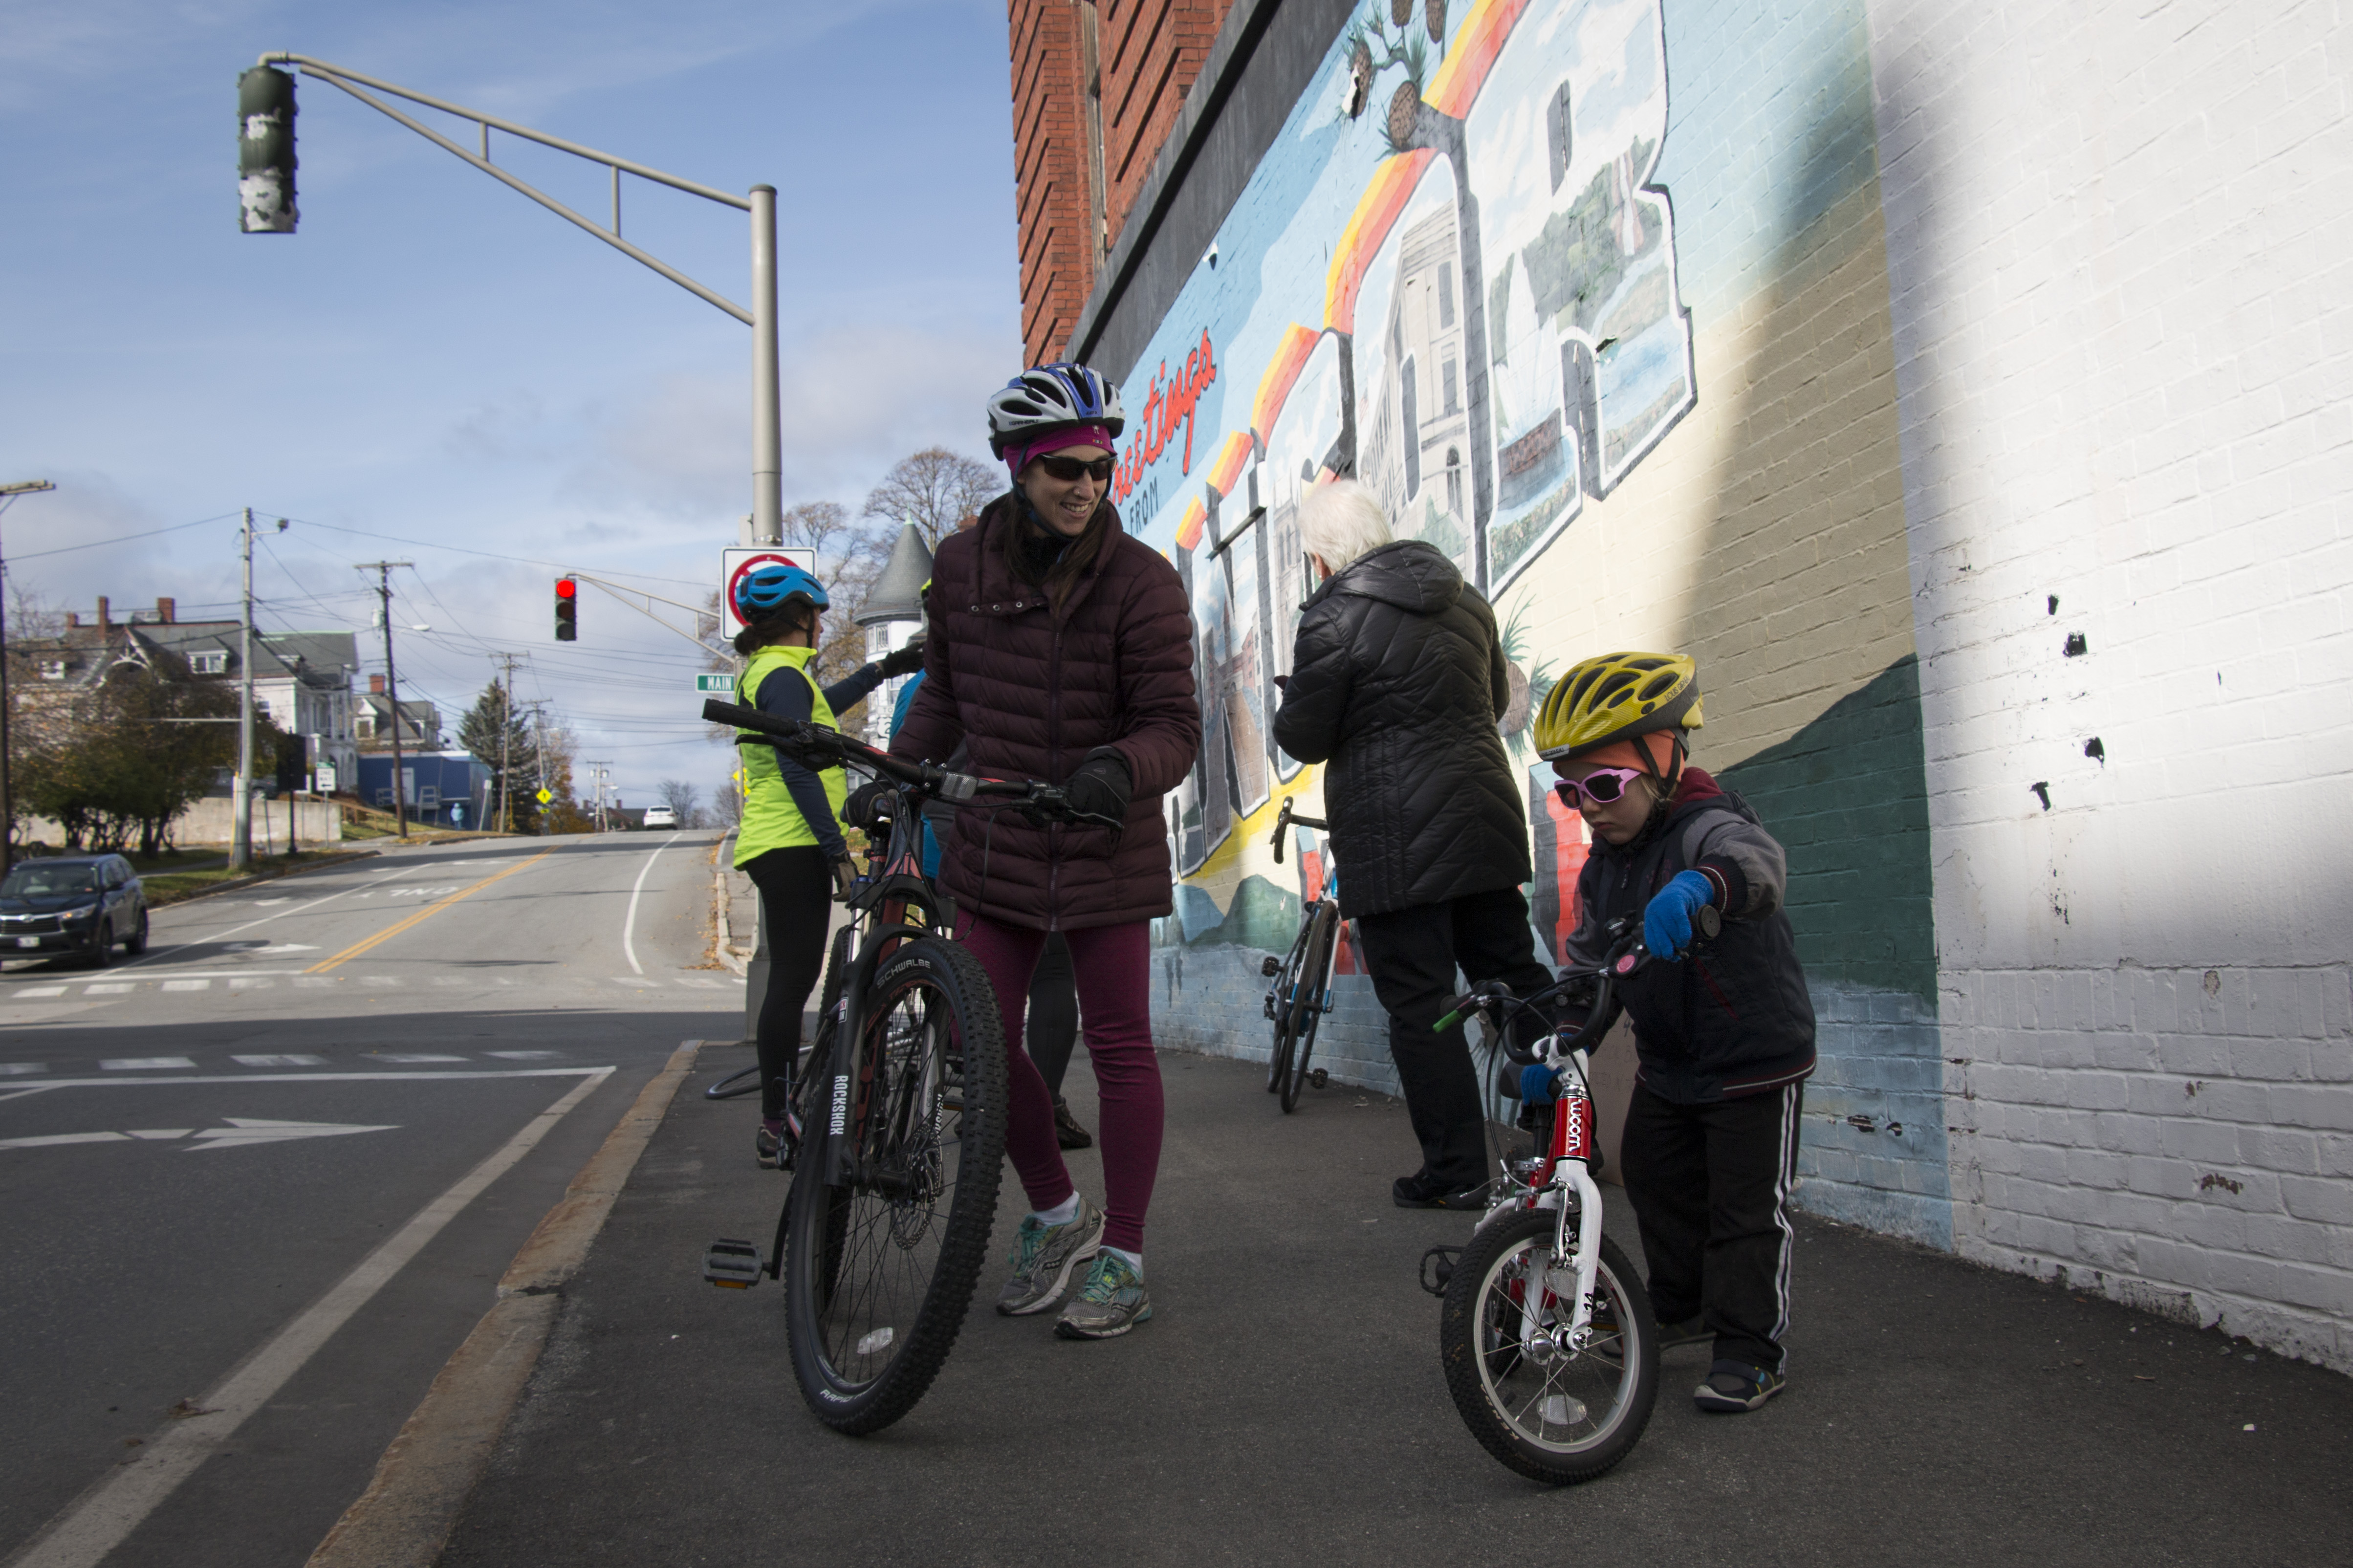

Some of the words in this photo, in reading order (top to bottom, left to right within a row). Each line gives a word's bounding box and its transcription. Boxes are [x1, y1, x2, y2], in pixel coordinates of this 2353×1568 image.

[1108, 326, 1217, 506] reetings
[1129, 477, 1158, 536] FROM
[707, 676, 731, 690] MAIN
[877, 958, 931, 989] SCHWALBE
[829, 1075, 849, 1136] ROCKSHOX
[1569, 1099, 1582, 1153] woom
[820, 1389, 854, 1403] RAPID
